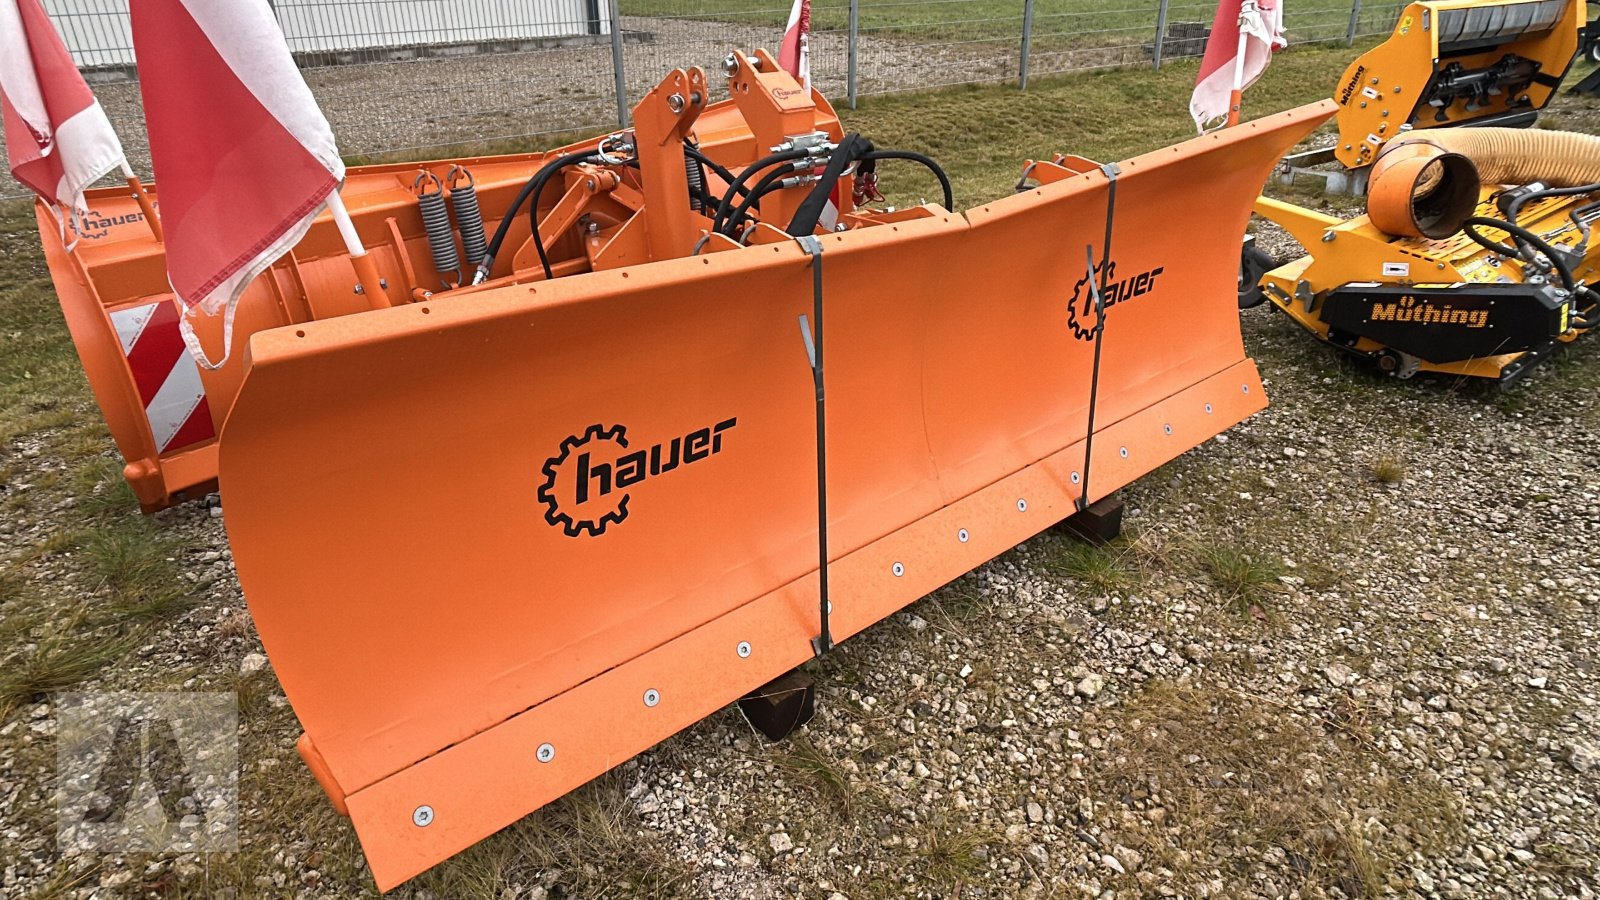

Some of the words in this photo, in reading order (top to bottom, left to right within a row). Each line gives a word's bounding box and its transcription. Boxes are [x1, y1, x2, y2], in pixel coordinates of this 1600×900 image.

[1341, 65, 1365, 106] Müthing
[82, 212, 144, 231] hauer
[1371, 296, 1488, 327] Müthing
[576, 417, 737, 505] hauer
